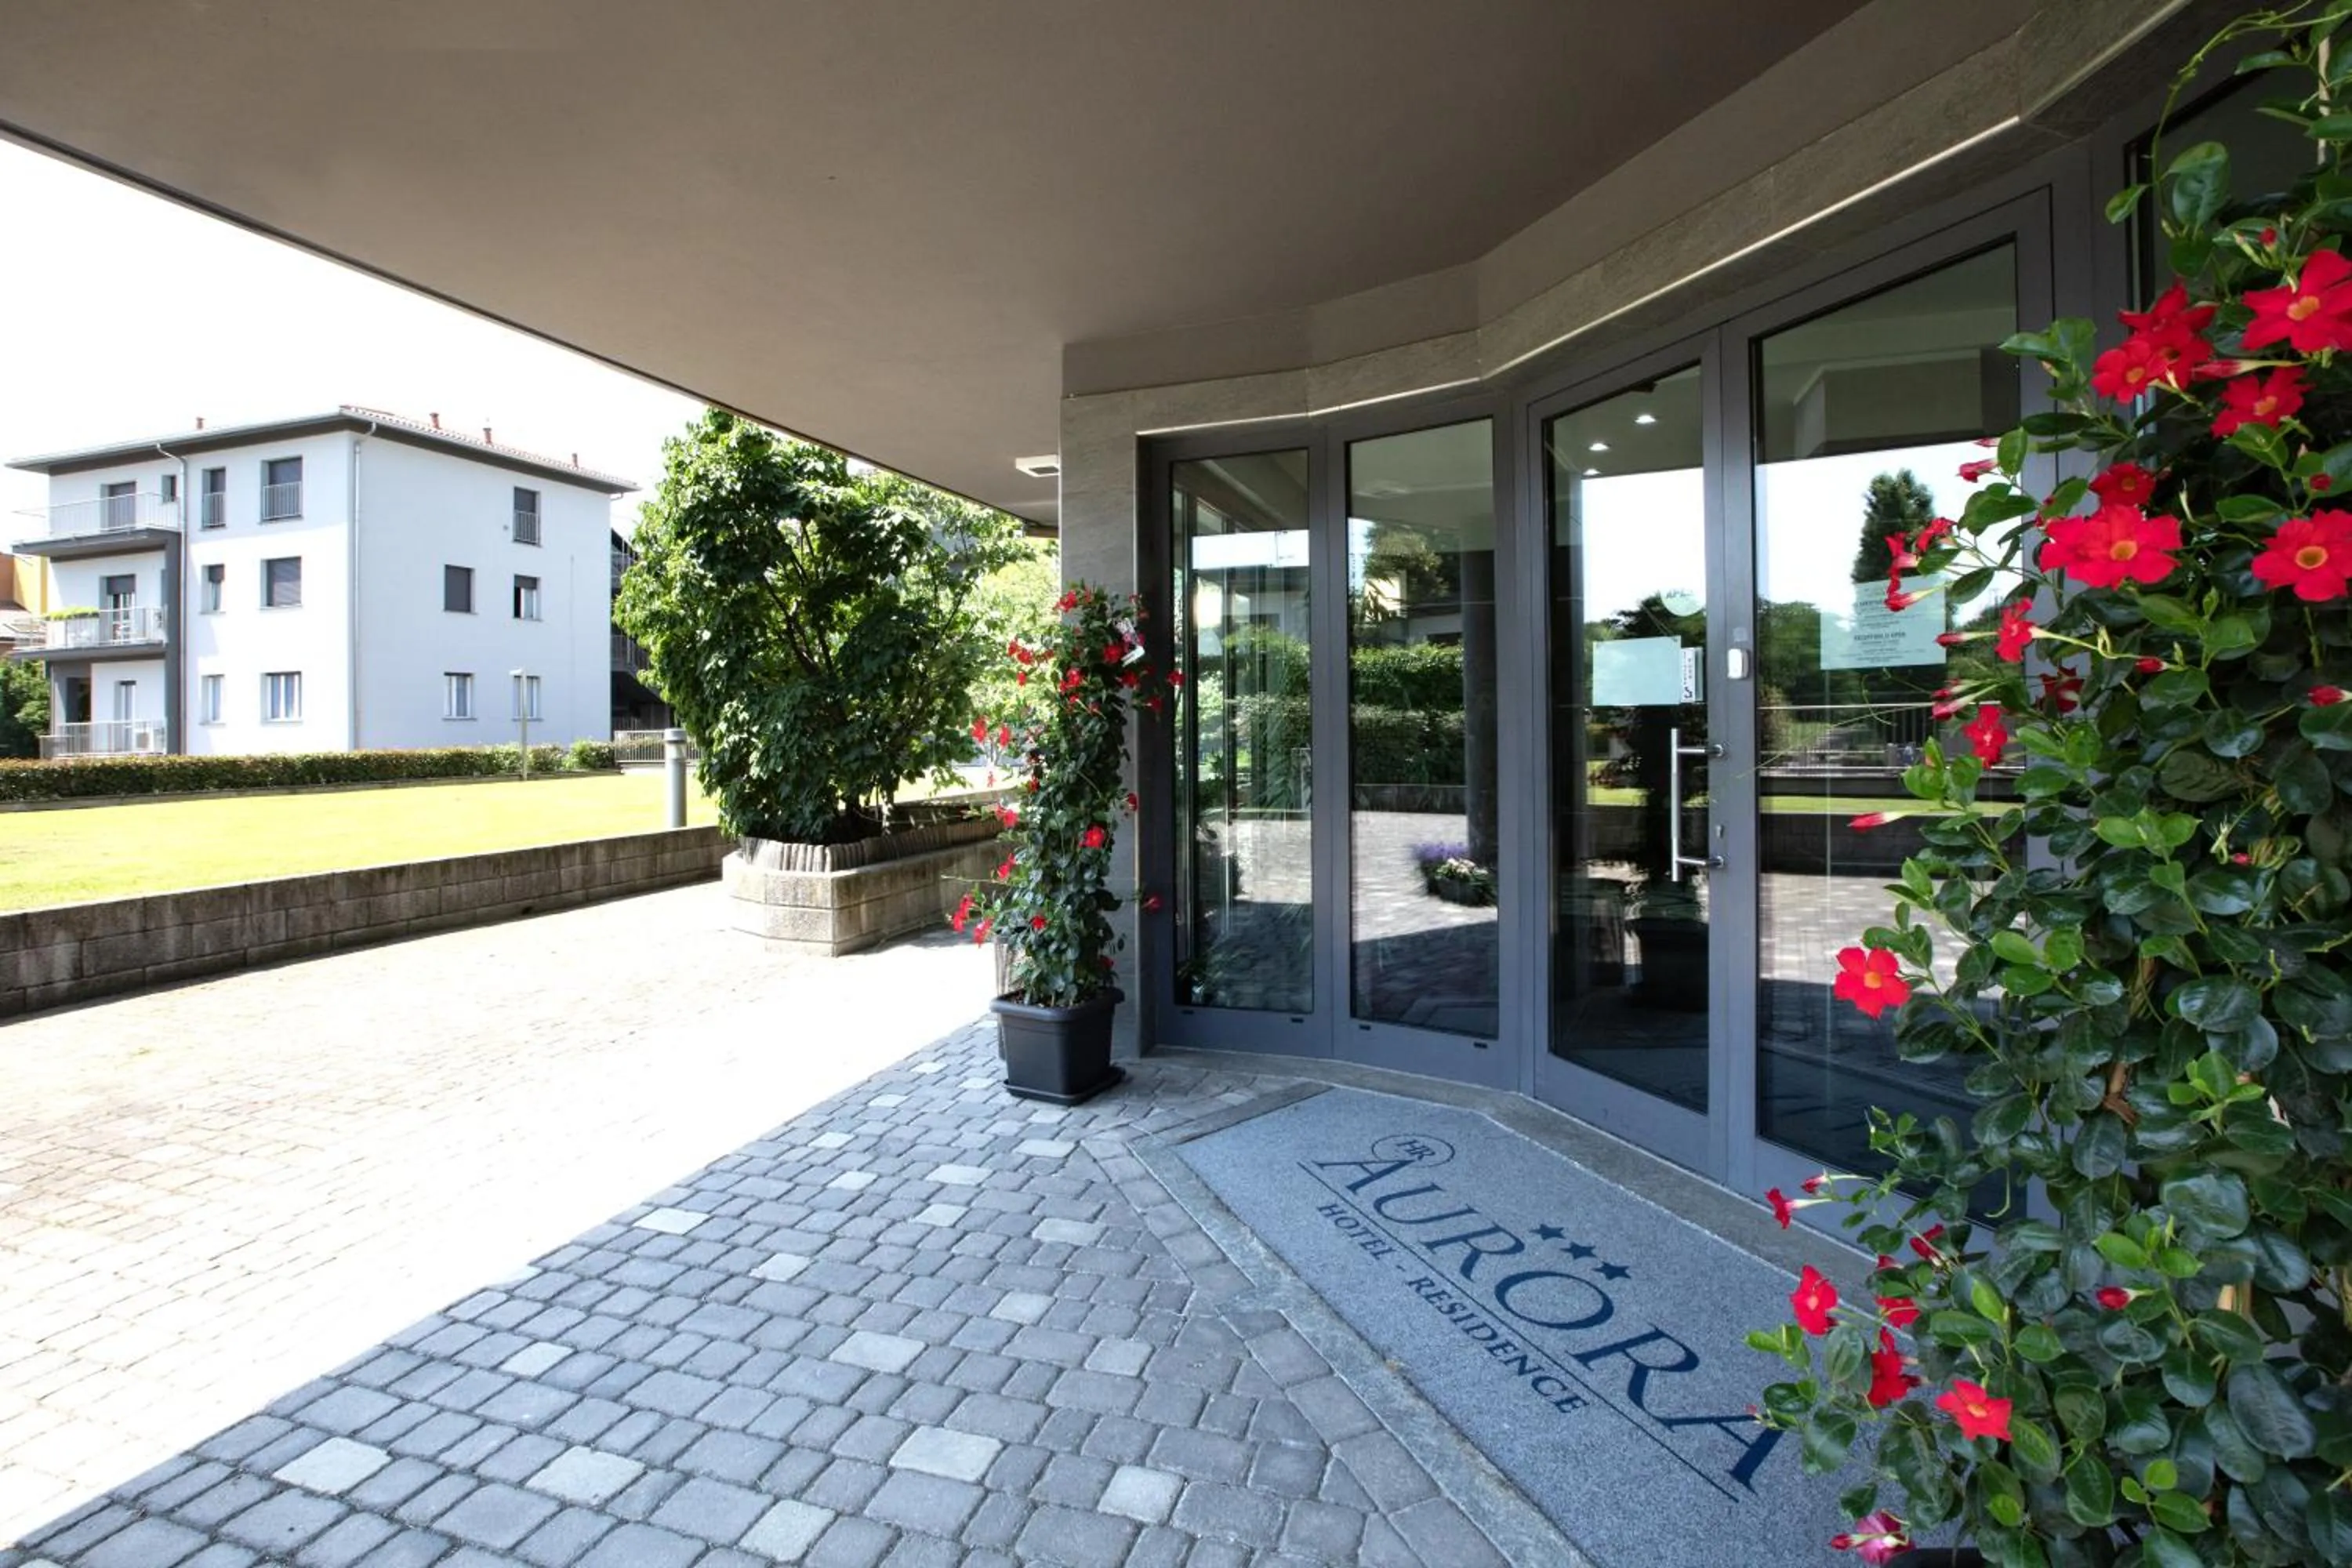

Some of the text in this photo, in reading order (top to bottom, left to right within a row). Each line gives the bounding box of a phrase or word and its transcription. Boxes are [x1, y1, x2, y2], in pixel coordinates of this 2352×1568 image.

[1312, 1159, 1788, 1495] AURORA
[1317, 1203, 1396, 1260] HOTEL
[1406, 1276, 1590, 1414] RESIDENCE
